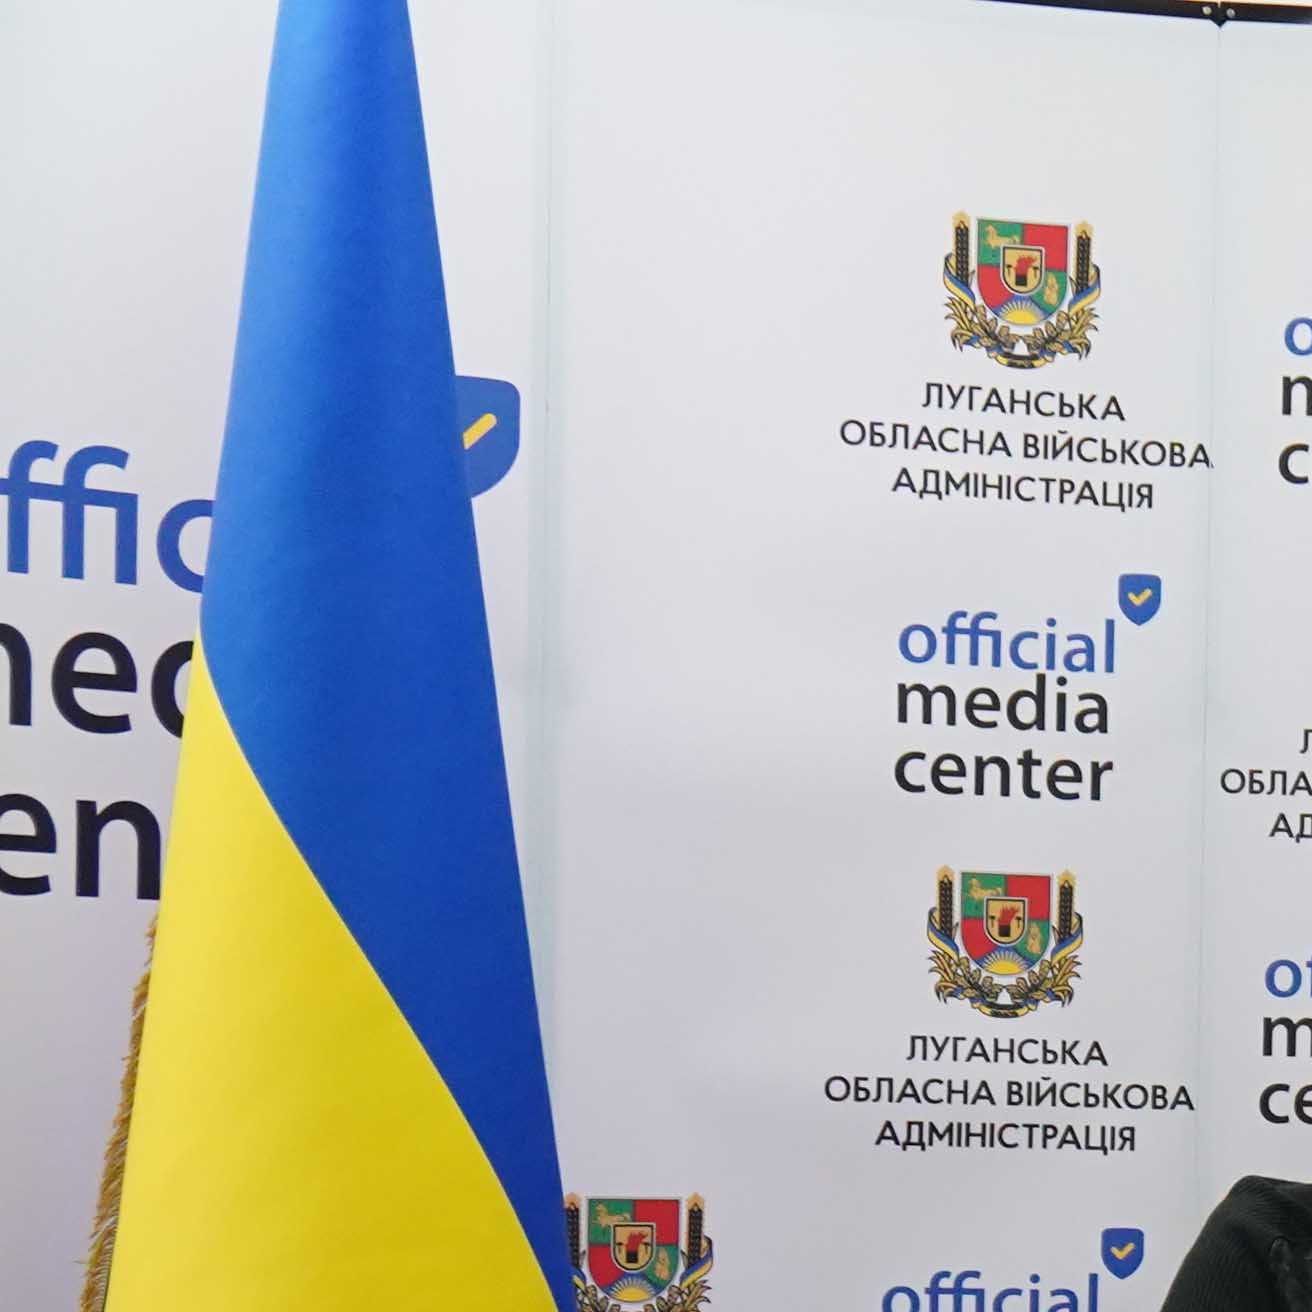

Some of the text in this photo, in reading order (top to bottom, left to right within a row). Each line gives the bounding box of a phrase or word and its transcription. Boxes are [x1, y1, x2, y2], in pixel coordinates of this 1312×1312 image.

[921, 382, 1126, 423] ЛУГАНСЬКА
[839, 419, 1214, 470] ОБЛАСНА ВІЙСЬКОВА
[891, 467, 1154, 513] АДМІНІСТРАЦІЯ
[0, 440, 214, 594] ffic
[898, 610, 1116, 673] official
[897, 673, 1110, 734] media
[894, 748, 1114, 802] center
[906, 1035, 1109, 1067] ЛУГАНСЬКА
[824, 1075, 1195, 1111] ОБЛАСНА ВІЙСЬКОВА
[874, 1120, 1137, 1153] АДМІНІСТРАЦІЯ
